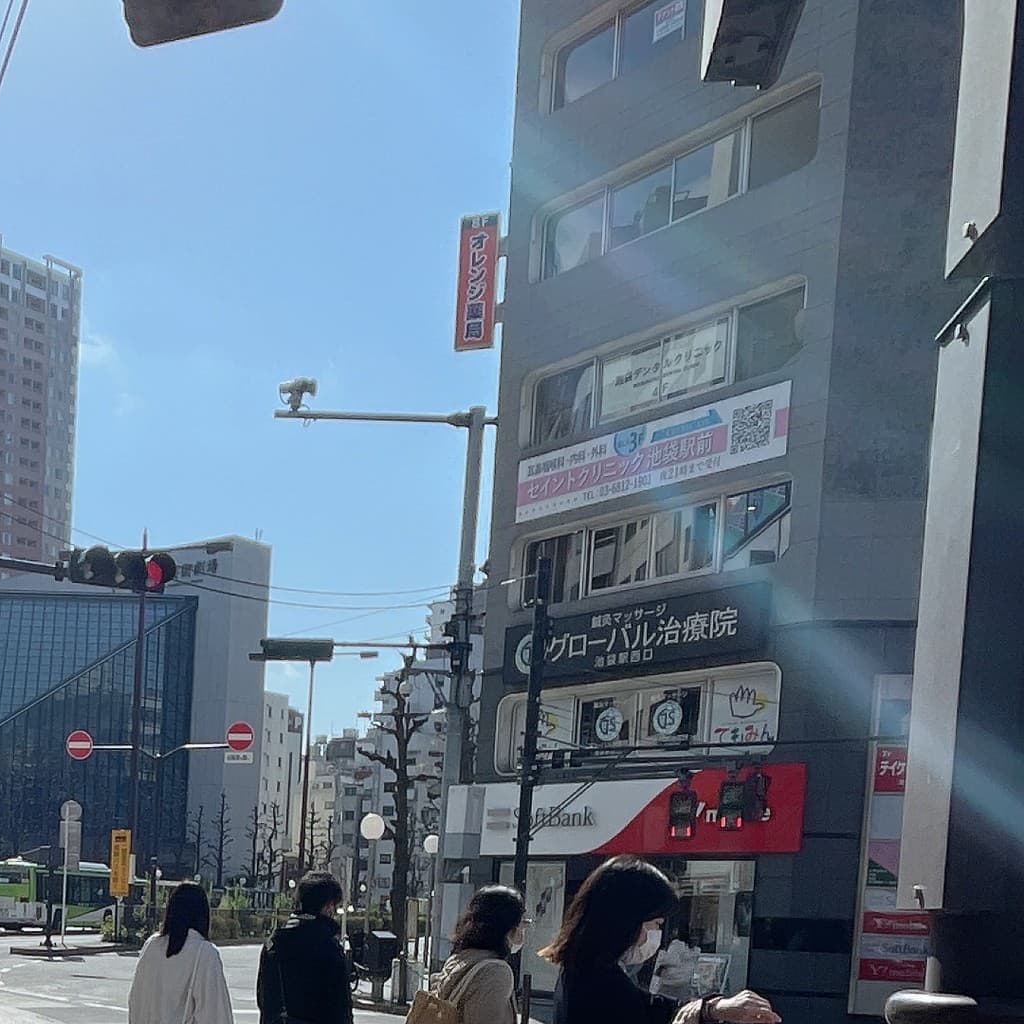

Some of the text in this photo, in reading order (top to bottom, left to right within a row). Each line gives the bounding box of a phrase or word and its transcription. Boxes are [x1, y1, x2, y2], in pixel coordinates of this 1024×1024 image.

[550, 607, 739, 662] グローバル治療院
